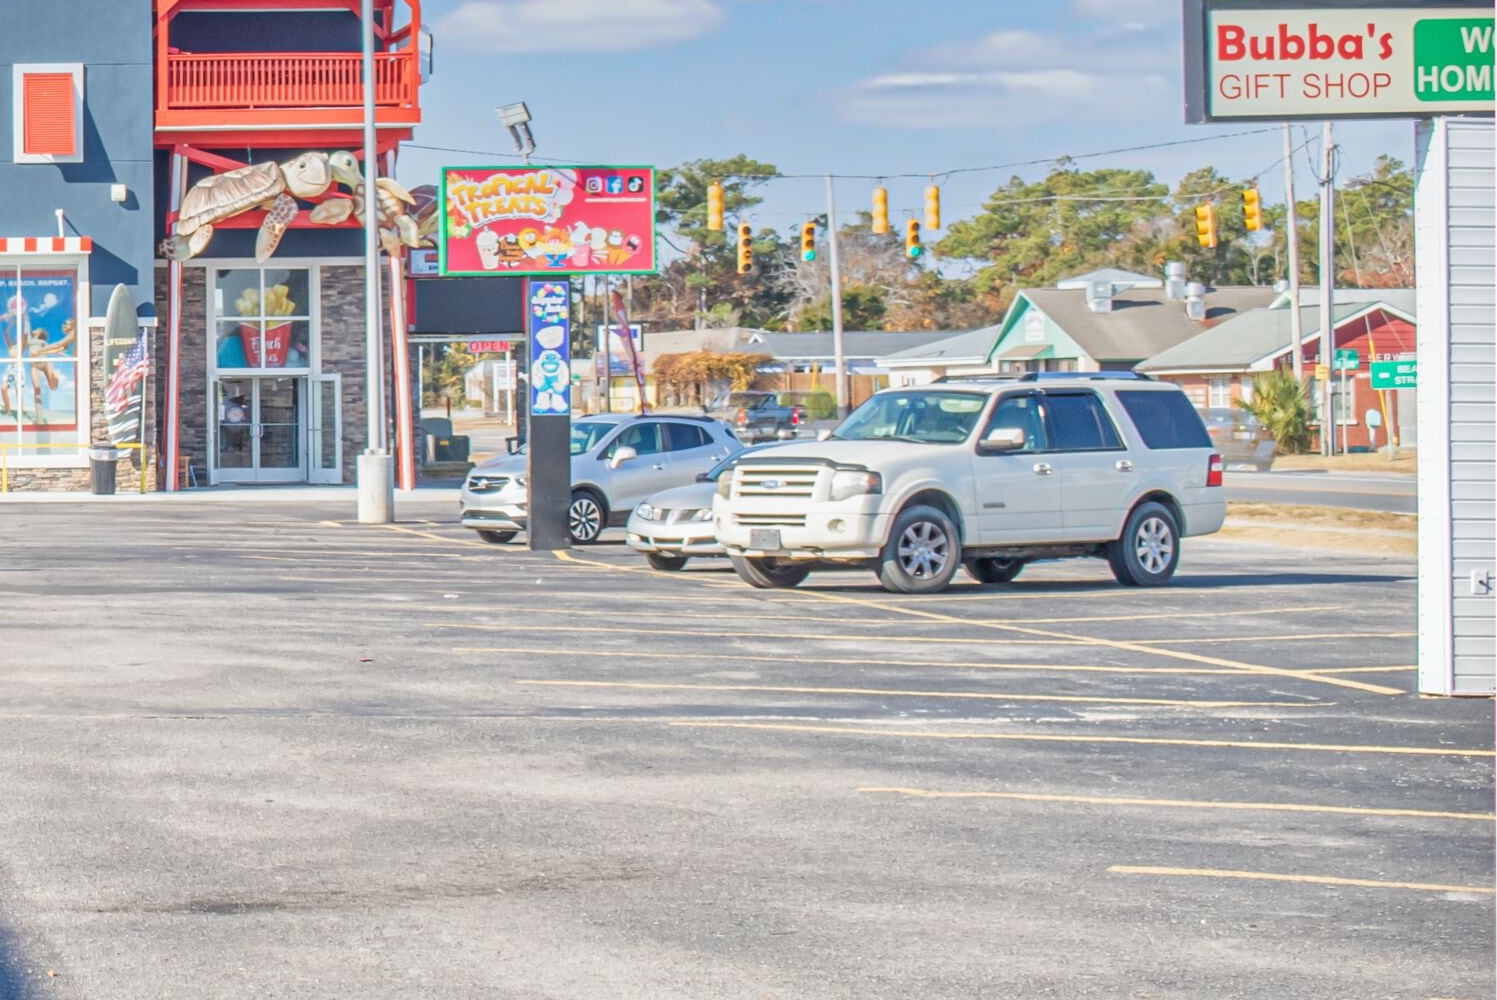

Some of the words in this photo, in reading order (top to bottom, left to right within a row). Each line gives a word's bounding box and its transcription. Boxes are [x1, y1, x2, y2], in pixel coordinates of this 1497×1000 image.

[1217, 23, 1393, 61] Bubba's
[1460, 26, 1495, 53] W
[1219, 73, 1291, 99] GIFT
[1302, 72, 1392, 99] SHOP
[1417, 65, 1495, 93] HOM
[451, 173, 555, 205] TROPICAL
[465, 194, 548, 222] TREATS
[469, 341, 509, 351] OPEN
